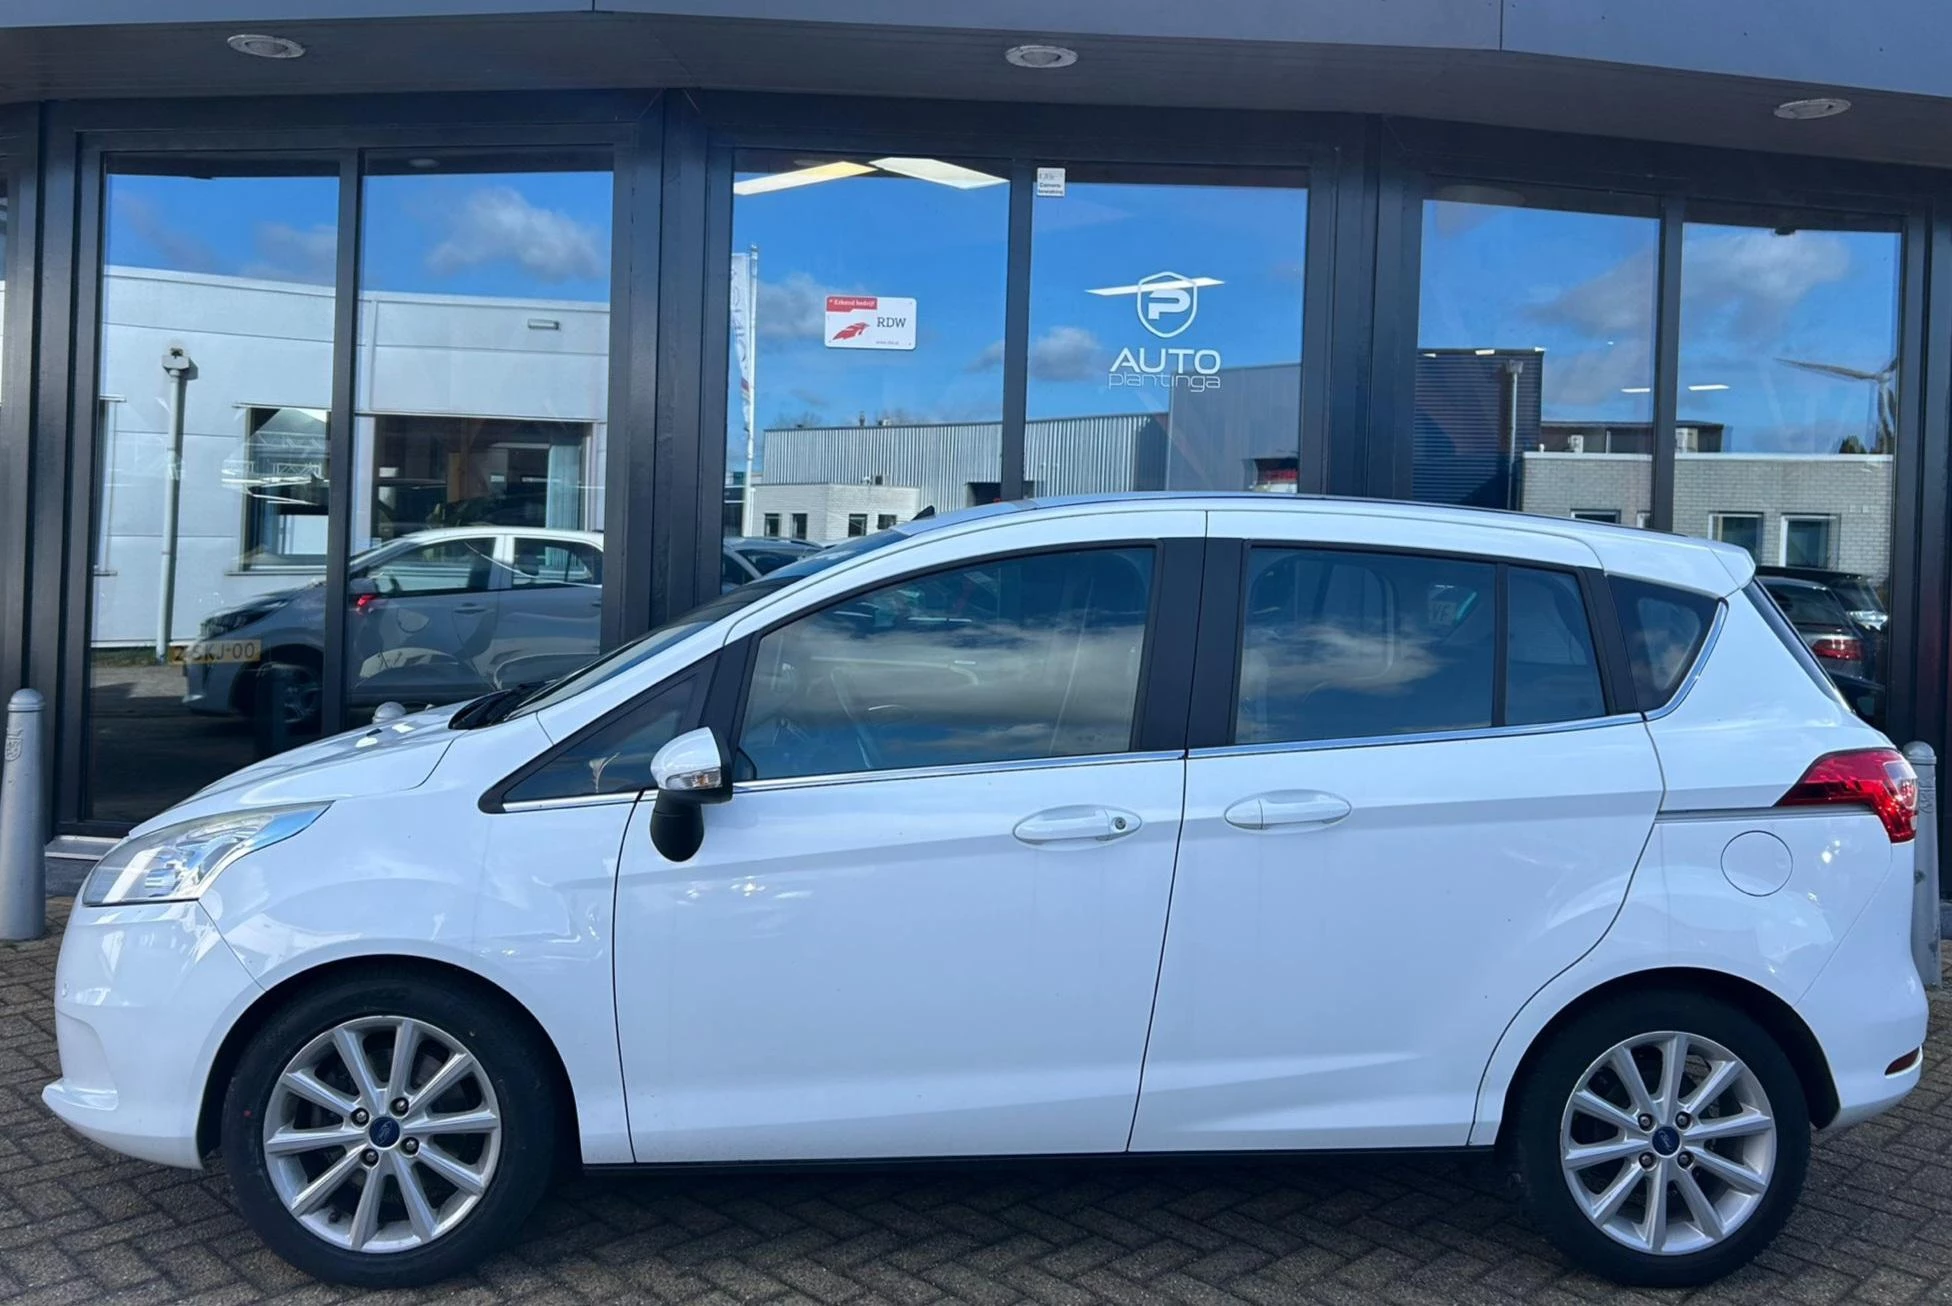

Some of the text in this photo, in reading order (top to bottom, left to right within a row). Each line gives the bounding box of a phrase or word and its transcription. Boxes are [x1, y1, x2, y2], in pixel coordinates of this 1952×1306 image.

[876, 316, 907, 329] RDW
[1109, 347, 1221, 374] AUTO
[1108, 371, 1221, 393] plantinga
